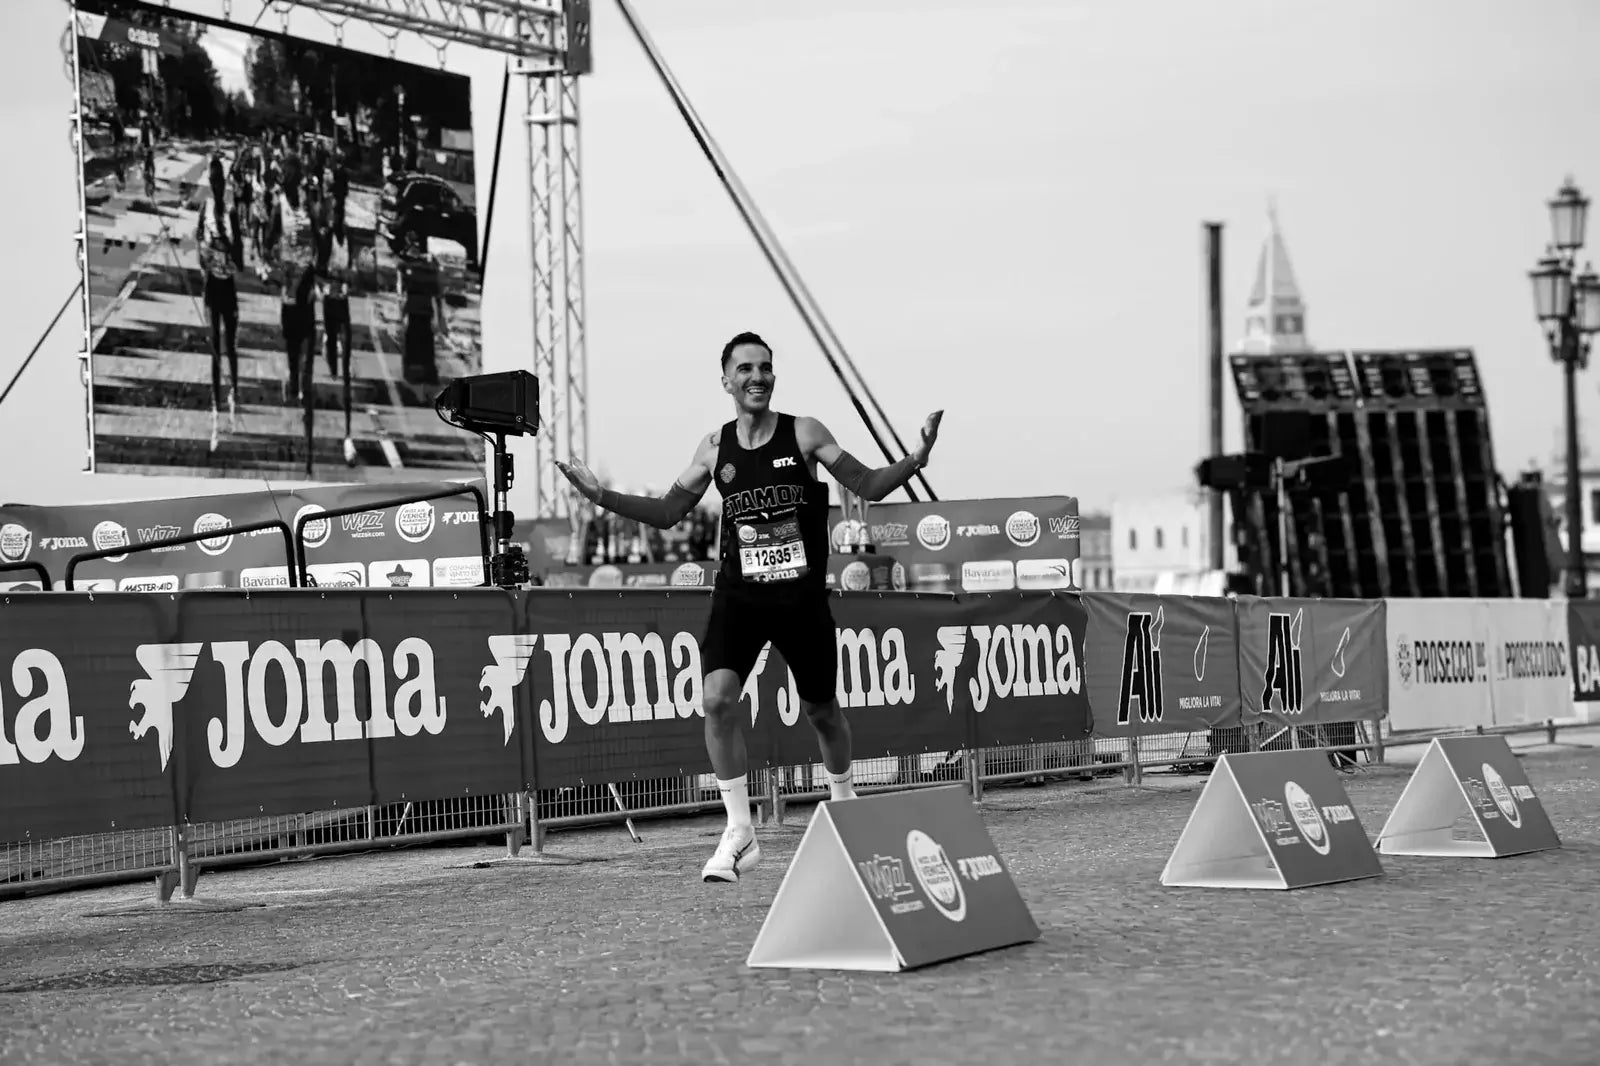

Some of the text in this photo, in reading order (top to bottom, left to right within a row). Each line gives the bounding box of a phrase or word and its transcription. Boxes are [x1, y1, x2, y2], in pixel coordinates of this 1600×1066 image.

[754, 547, 791, 566] 12635
[242, 575, 287, 587] Bavaria
[1414, 640, 1475, 684] PROSECCO
[1178, 696, 1203, 709] MIGLIORA
[1203, 695, 1210, 707] LA
